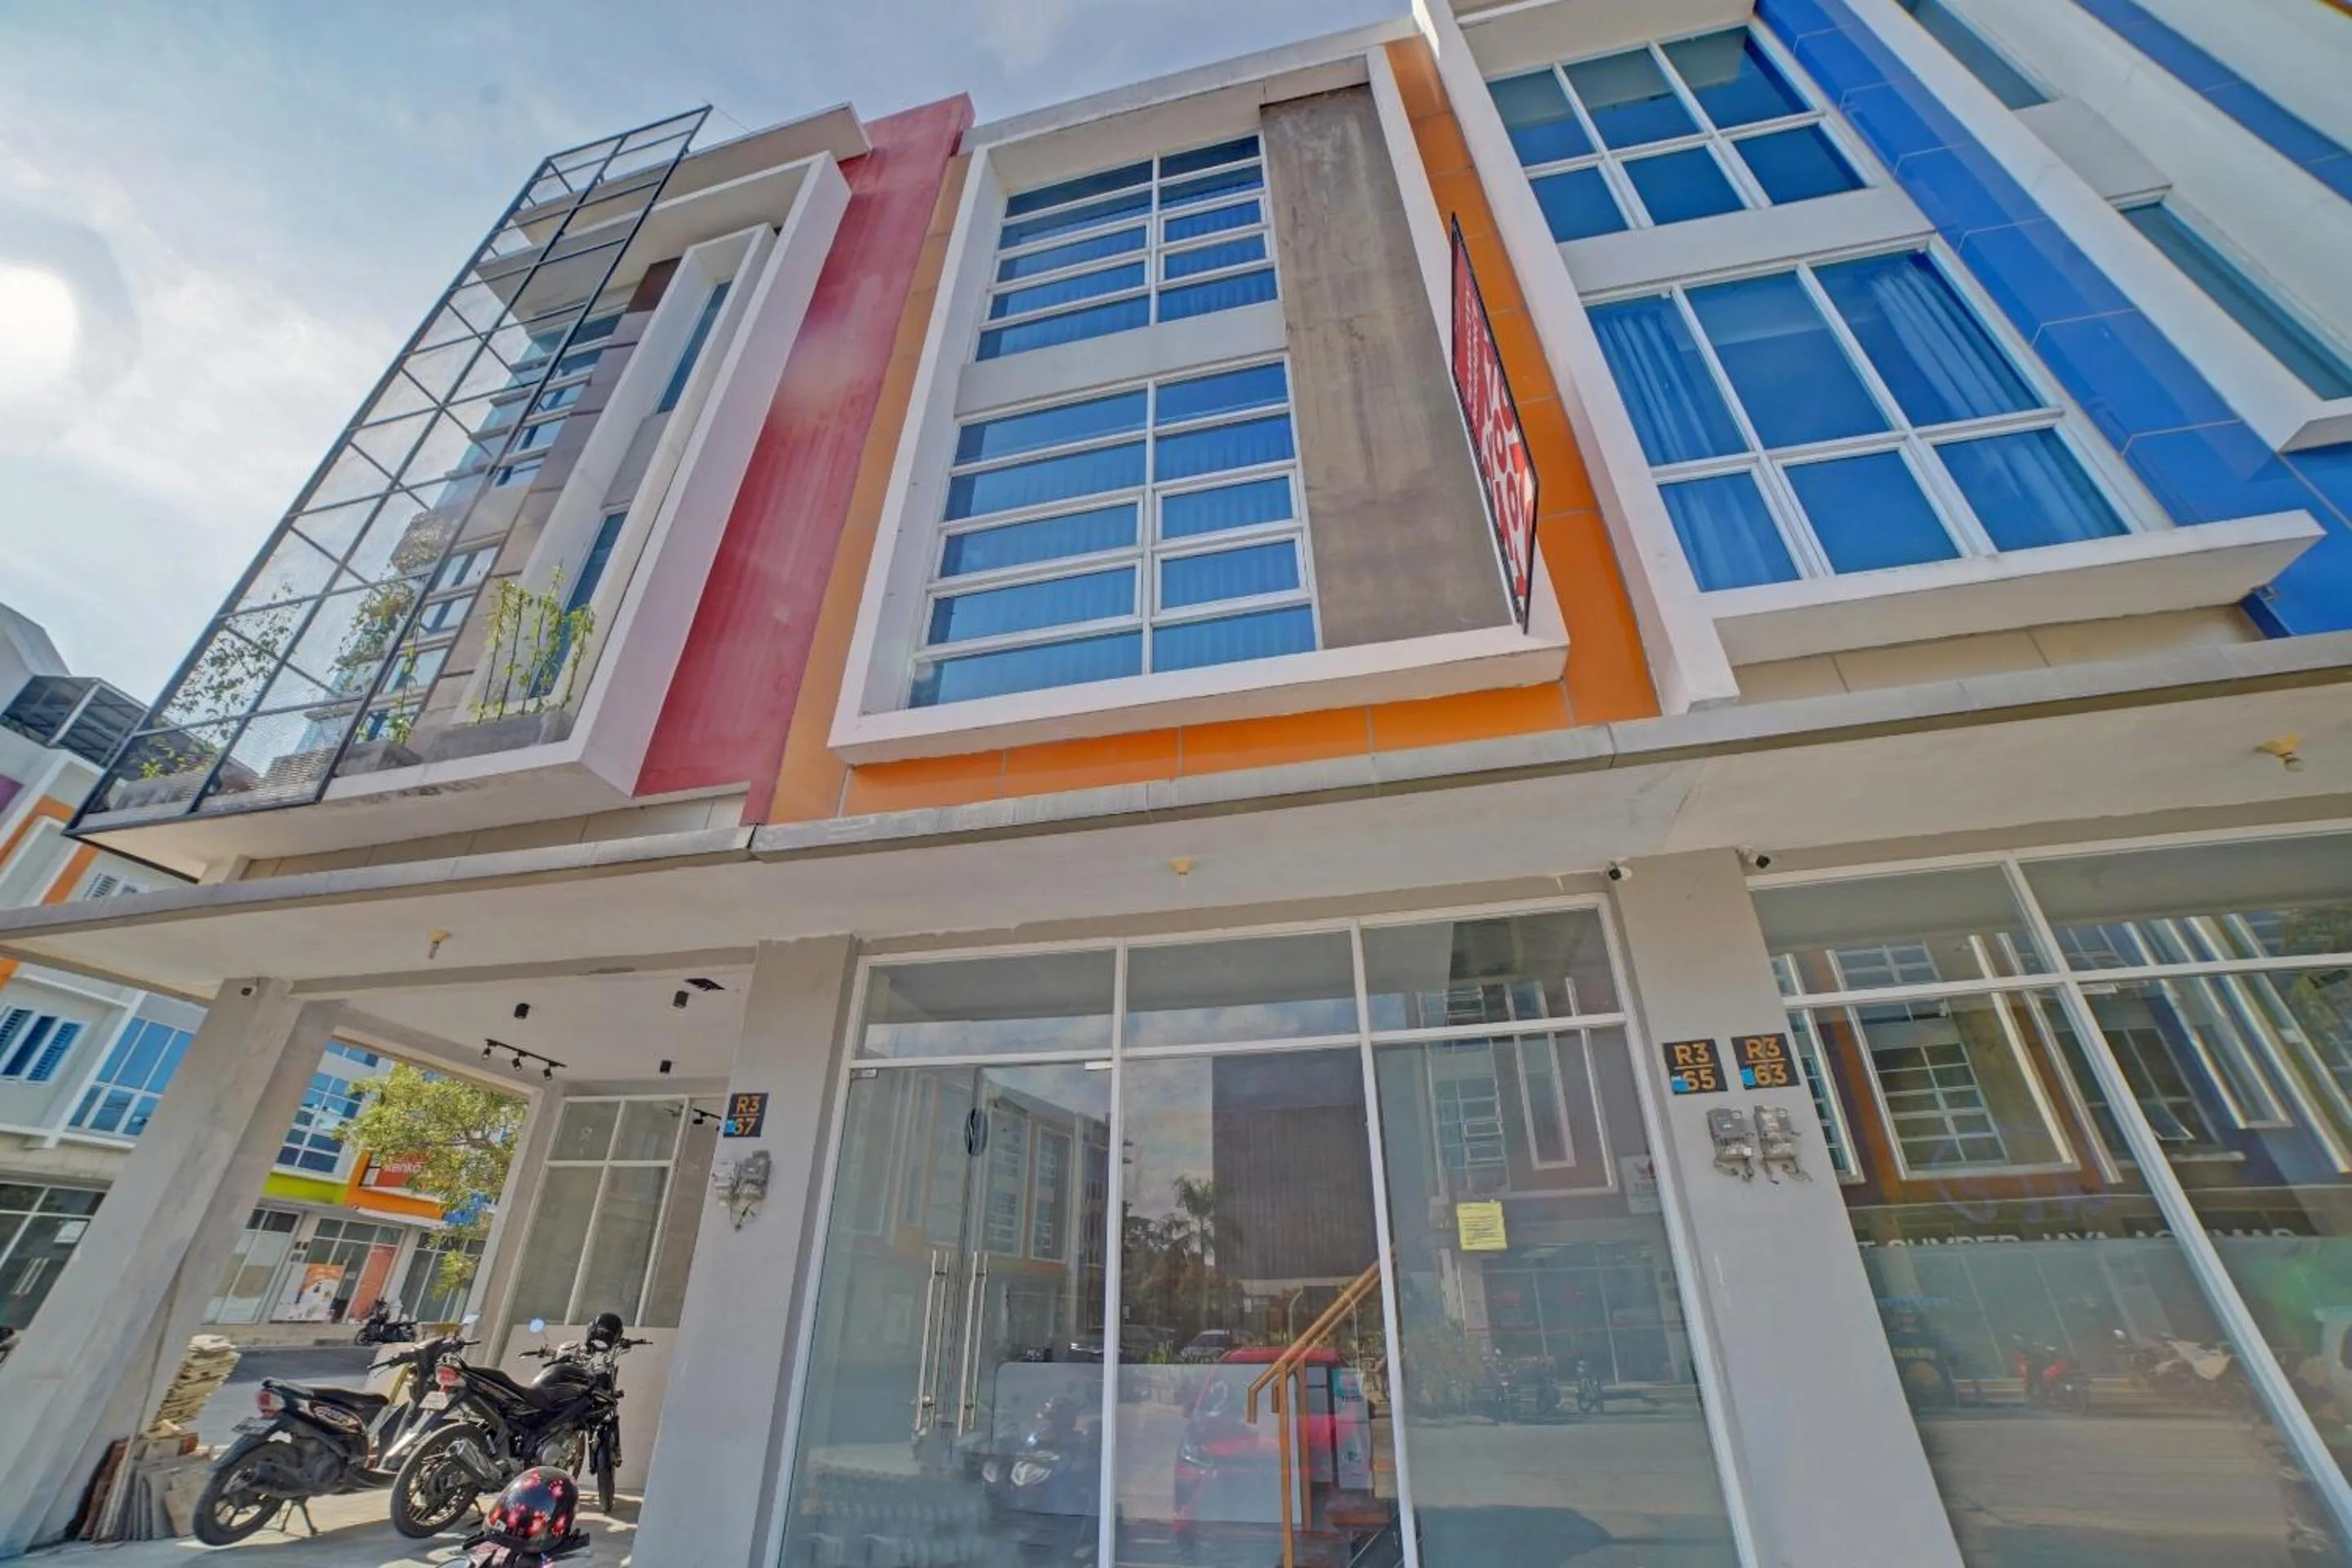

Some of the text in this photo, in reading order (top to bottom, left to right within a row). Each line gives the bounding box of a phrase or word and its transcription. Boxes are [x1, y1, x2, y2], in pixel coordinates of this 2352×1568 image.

[1674, 1042, 1710, 1065] R3
[1744, 1037, 1781, 1059] R3
[1754, 1063, 1788, 1086] 63
[737, 1096, 761, 1114] R3
